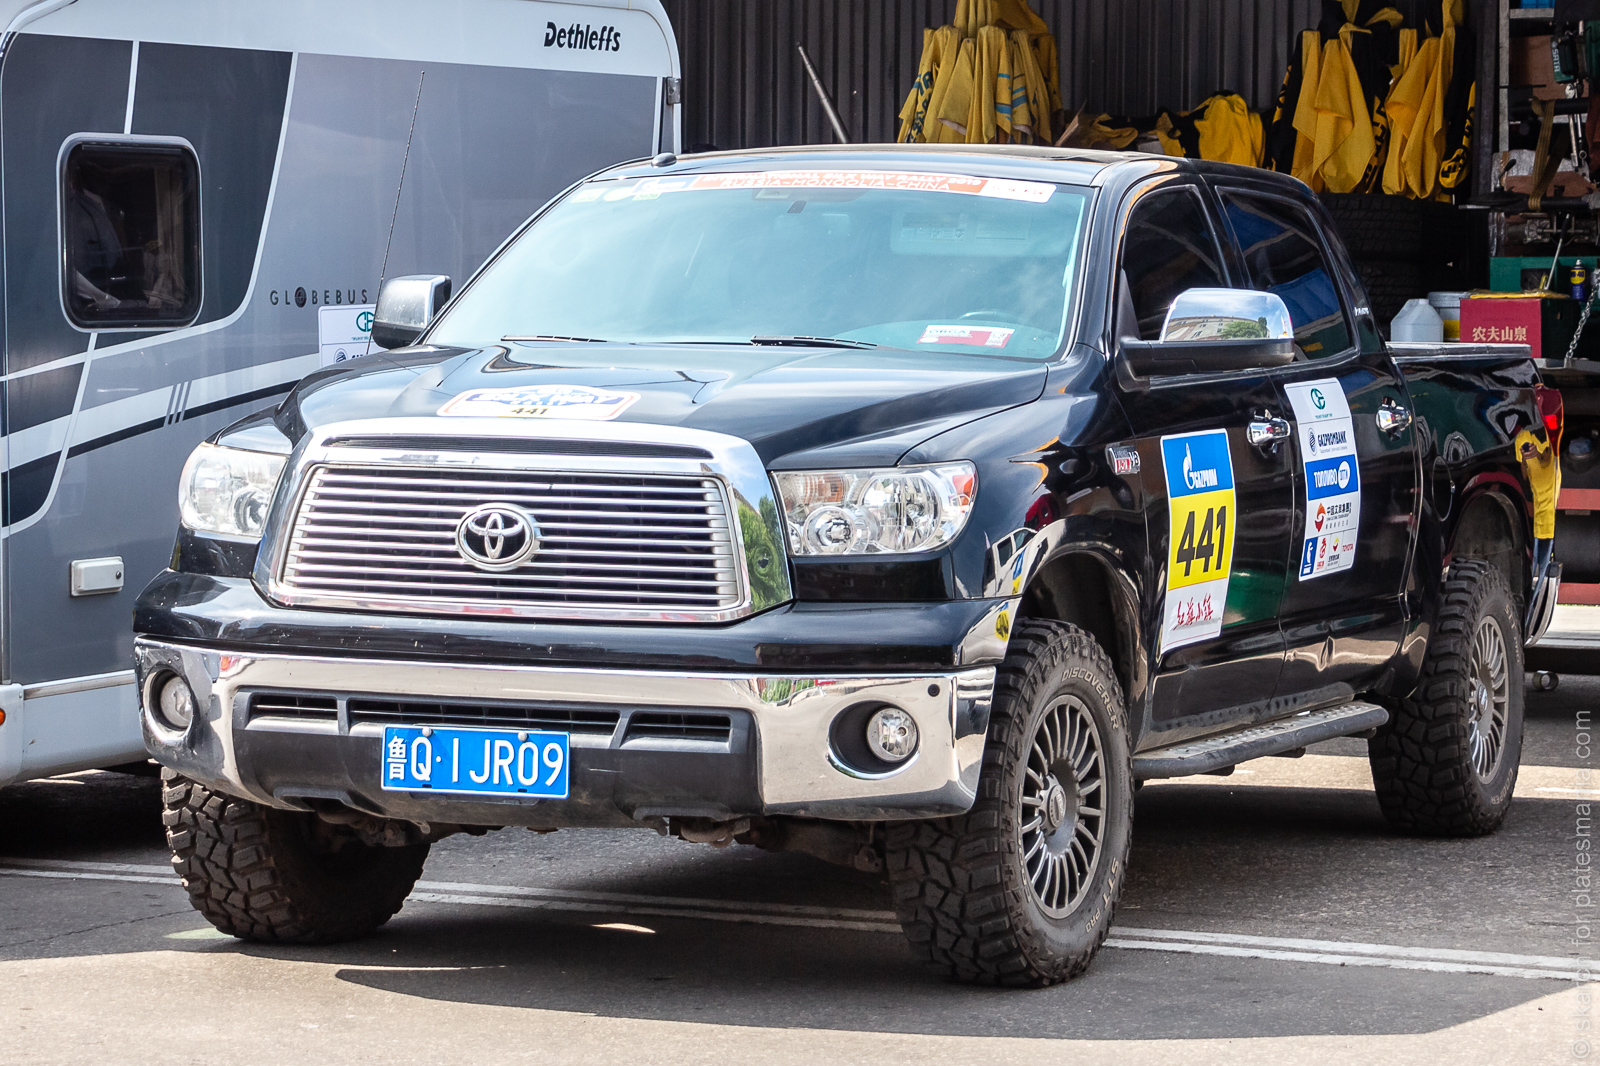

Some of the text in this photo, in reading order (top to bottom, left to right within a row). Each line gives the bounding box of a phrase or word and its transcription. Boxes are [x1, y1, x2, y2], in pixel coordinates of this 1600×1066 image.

[544, 21, 621, 52] Dethleffs
[822, 172, 858, 180] SILK
[860, 173, 896, 181] WAY
[896, 174, 947, 184] RALLY
[270, 286, 368, 308] GLOBEBUS
[1472, 326, 1527, 342] 农夫山泉
[510, 407, 549, 415] 441
[1176, 505, 1226, 577] 441
[1062, 666, 1119, 730] DISCOVERER
